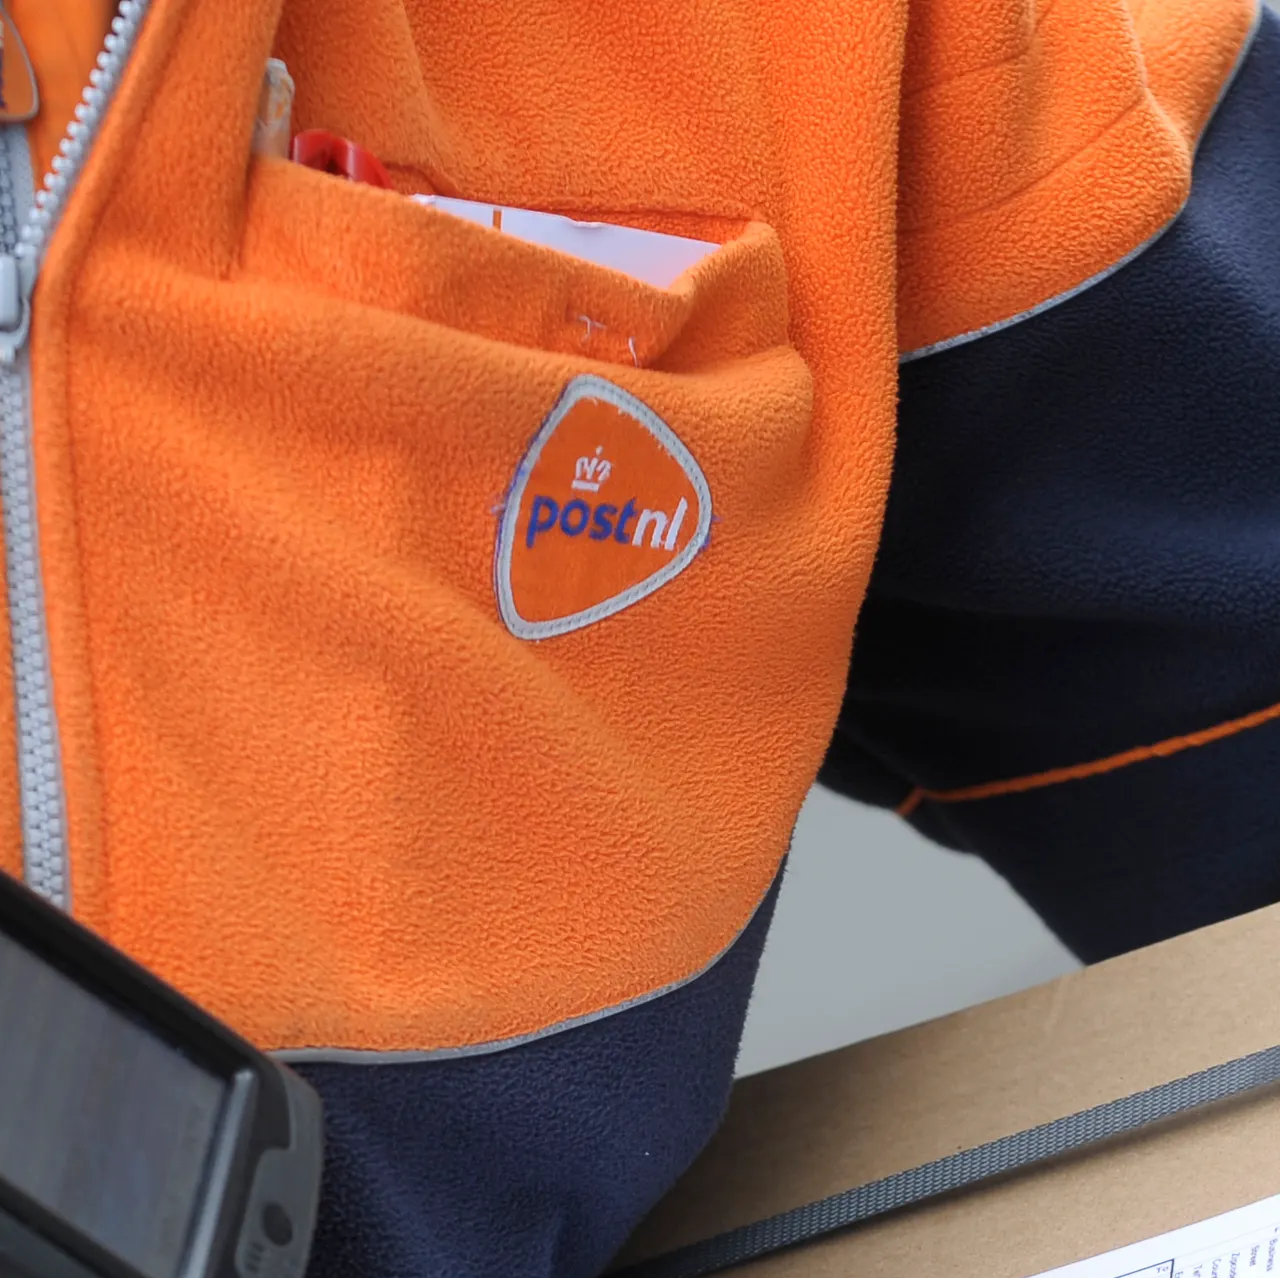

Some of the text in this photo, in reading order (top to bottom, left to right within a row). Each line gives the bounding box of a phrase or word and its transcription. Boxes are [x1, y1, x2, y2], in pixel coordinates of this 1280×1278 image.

[526, 494, 688, 551] postnl
[1248, 1244, 1260, 1267] Street
[1265, 1237, 1278, 1272] Business
